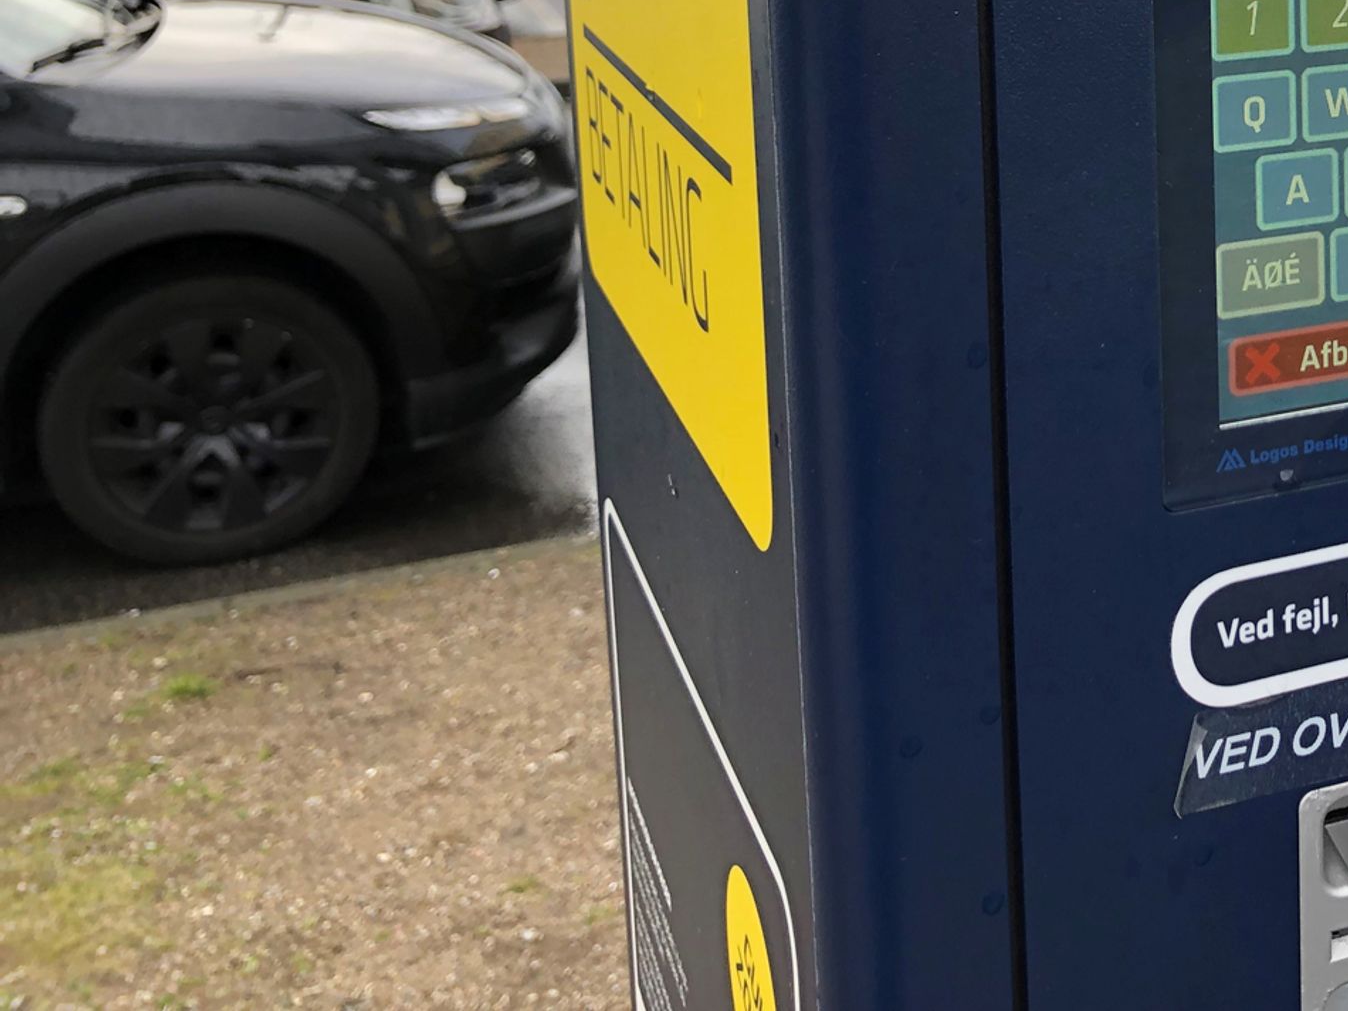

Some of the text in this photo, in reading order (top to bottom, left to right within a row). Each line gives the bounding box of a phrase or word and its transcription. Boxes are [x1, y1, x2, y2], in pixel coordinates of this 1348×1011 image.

[1246, 0, 1259, 36] 1
[1243, 95, 1266, 133] Q
[584, 67, 710, 333] BETALING
[1285, 174, 1310, 206] A
[1241, 251, 1300, 292] ÄØÉ
[1250, 444, 1298, 466] Logos
[1216, 607, 1274, 649] Ved
[1282, 595, 1339, 635] fejl,
[1194, 726, 1280, 781] VED
